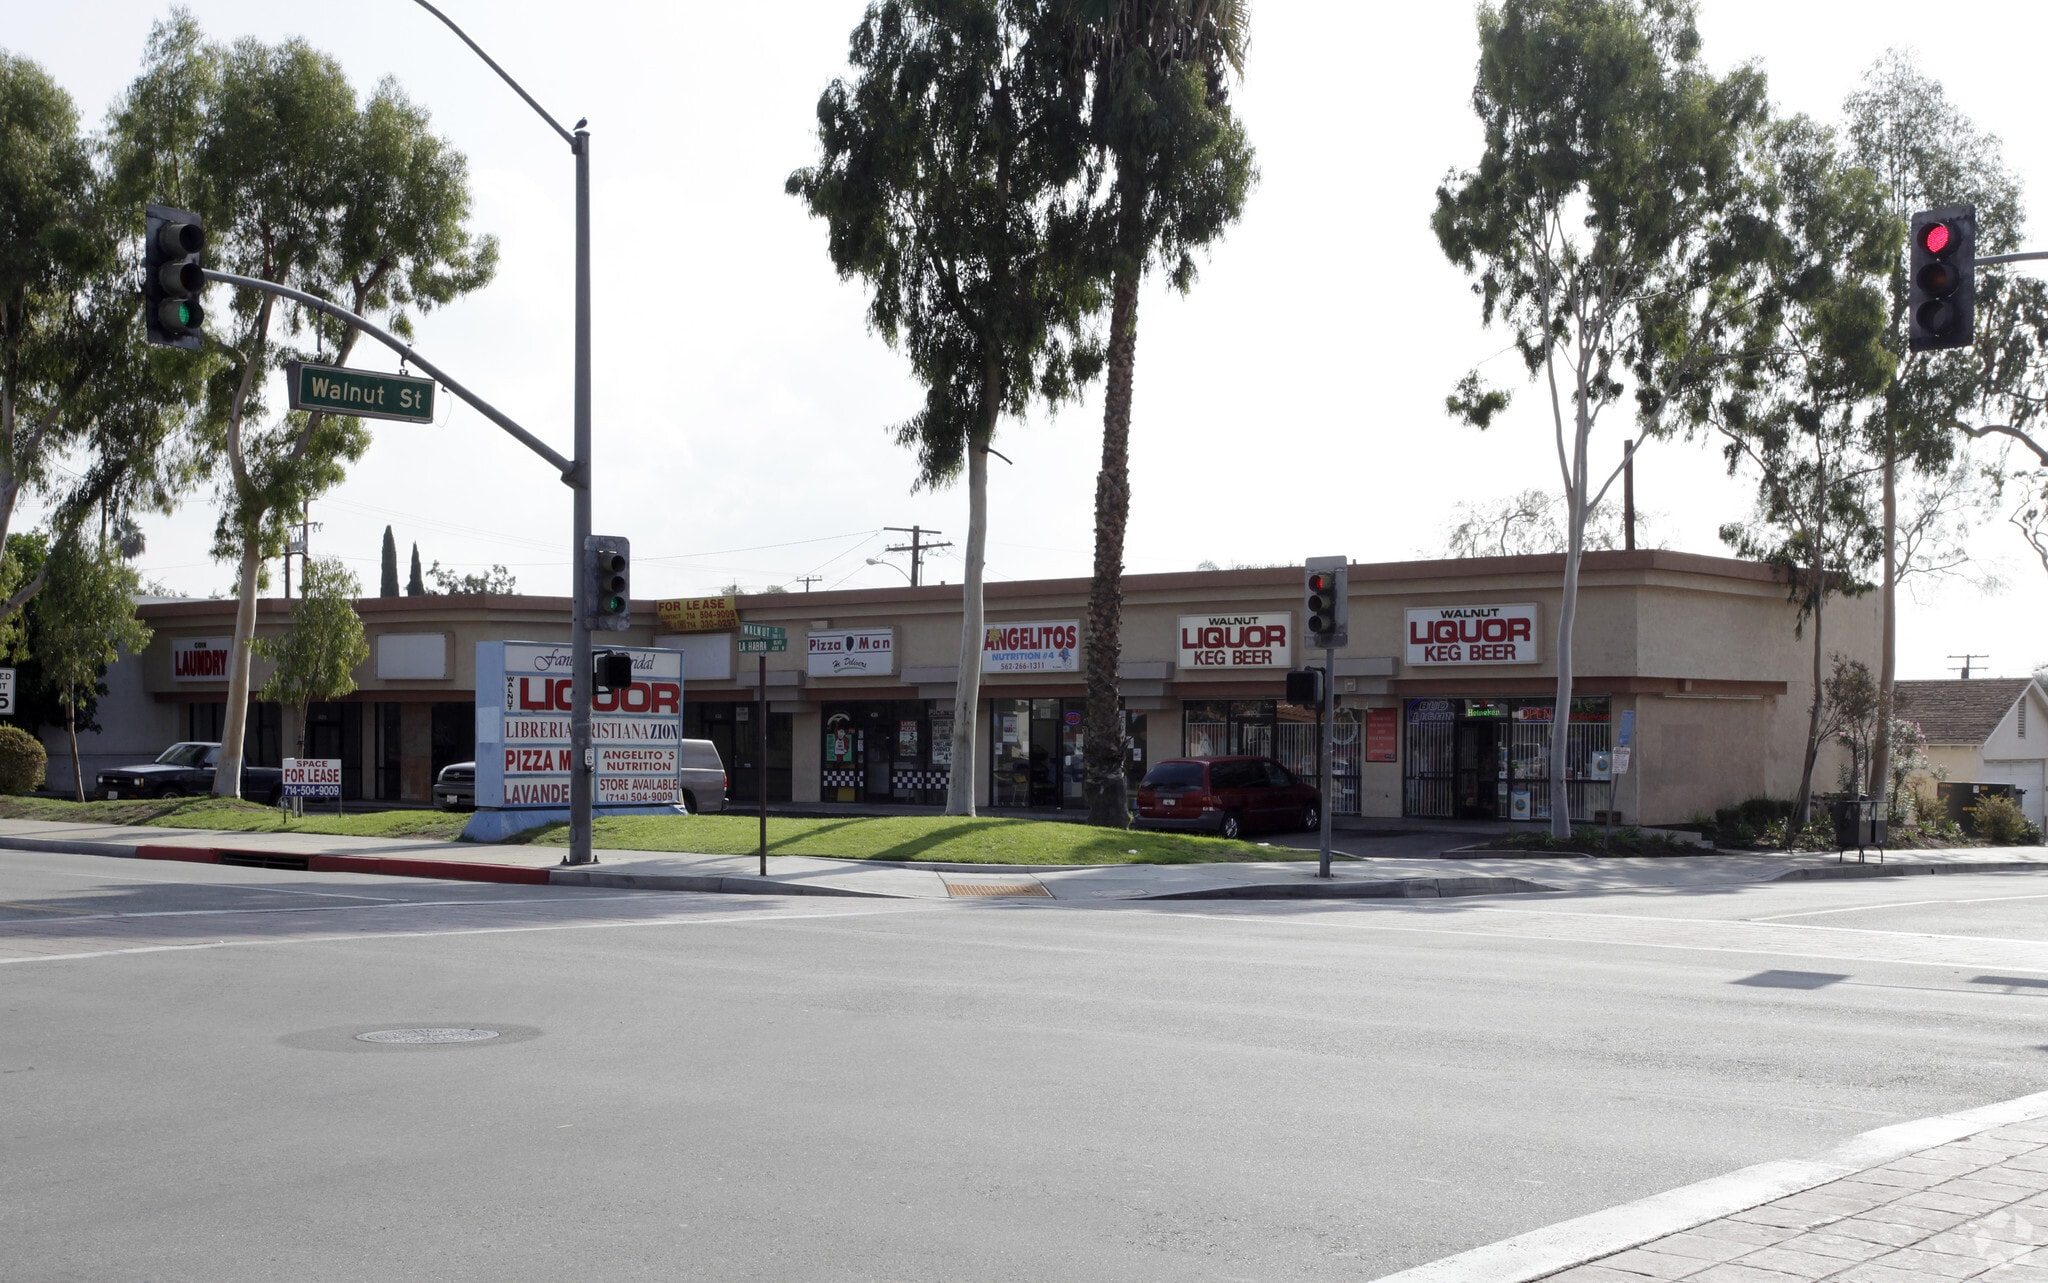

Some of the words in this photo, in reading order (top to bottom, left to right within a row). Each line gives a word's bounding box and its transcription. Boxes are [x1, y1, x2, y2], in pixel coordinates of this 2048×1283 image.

[312, 376, 384, 405] Walnut
[399, 388, 422, 409] St
[658, 602, 680, 611] FOR
[1441, 608, 1499, 618] WALNUT
[700, 610, 735, 619] 504-9009
[1209, 617, 1258, 625] WALNUT
[743, 624, 770, 637] WALNUT
[1182, 625, 1286, 649] LIQUOR
[1410, 618, 1531, 644] LIQUOR
[809, 639, 841, 651] Pizza
[859, 637, 890, 649] Man
[984, 625, 1076, 651] ANGELITOS
[738, 642, 746, 651] LA
[748, 641, 767, 651] HABRA
[1425, 645, 1461, 661] KEG
[1469, 644, 1516, 660] BEER
[175, 650, 228, 676] LAUNDRY
[992, 652, 1040, 661] NUTRITION
[1194, 650, 1226, 665] KEG
[1233, 650, 1272, 665] BEER
[1001, 662, 1044, 670] 562-266-1311
[506, 676, 515, 710] WALNUT
[1467, 709, 1500, 717] Heineken
[1522, 708, 1552, 720] OPEN
[506, 721, 572, 739] LIBRERIA
[591, 723, 649, 739] RISTIANA
[650, 724, 679, 739] ZION
[505, 749, 554, 771] PIZZA
[607, 762, 671, 771] NUTRITION
[285, 769, 305, 782] FOR
[308, 769, 339, 782] LEASE
[284, 786, 340, 796] 714-504-9009
[600, 779, 628, 791] STORE
[632, 778, 677, 790] AVAILABLE
[504, 784, 569, 803] LAVANDE
[606, 793, 628, 801] (714)
[631, 792, 673, 801] 504-9009
